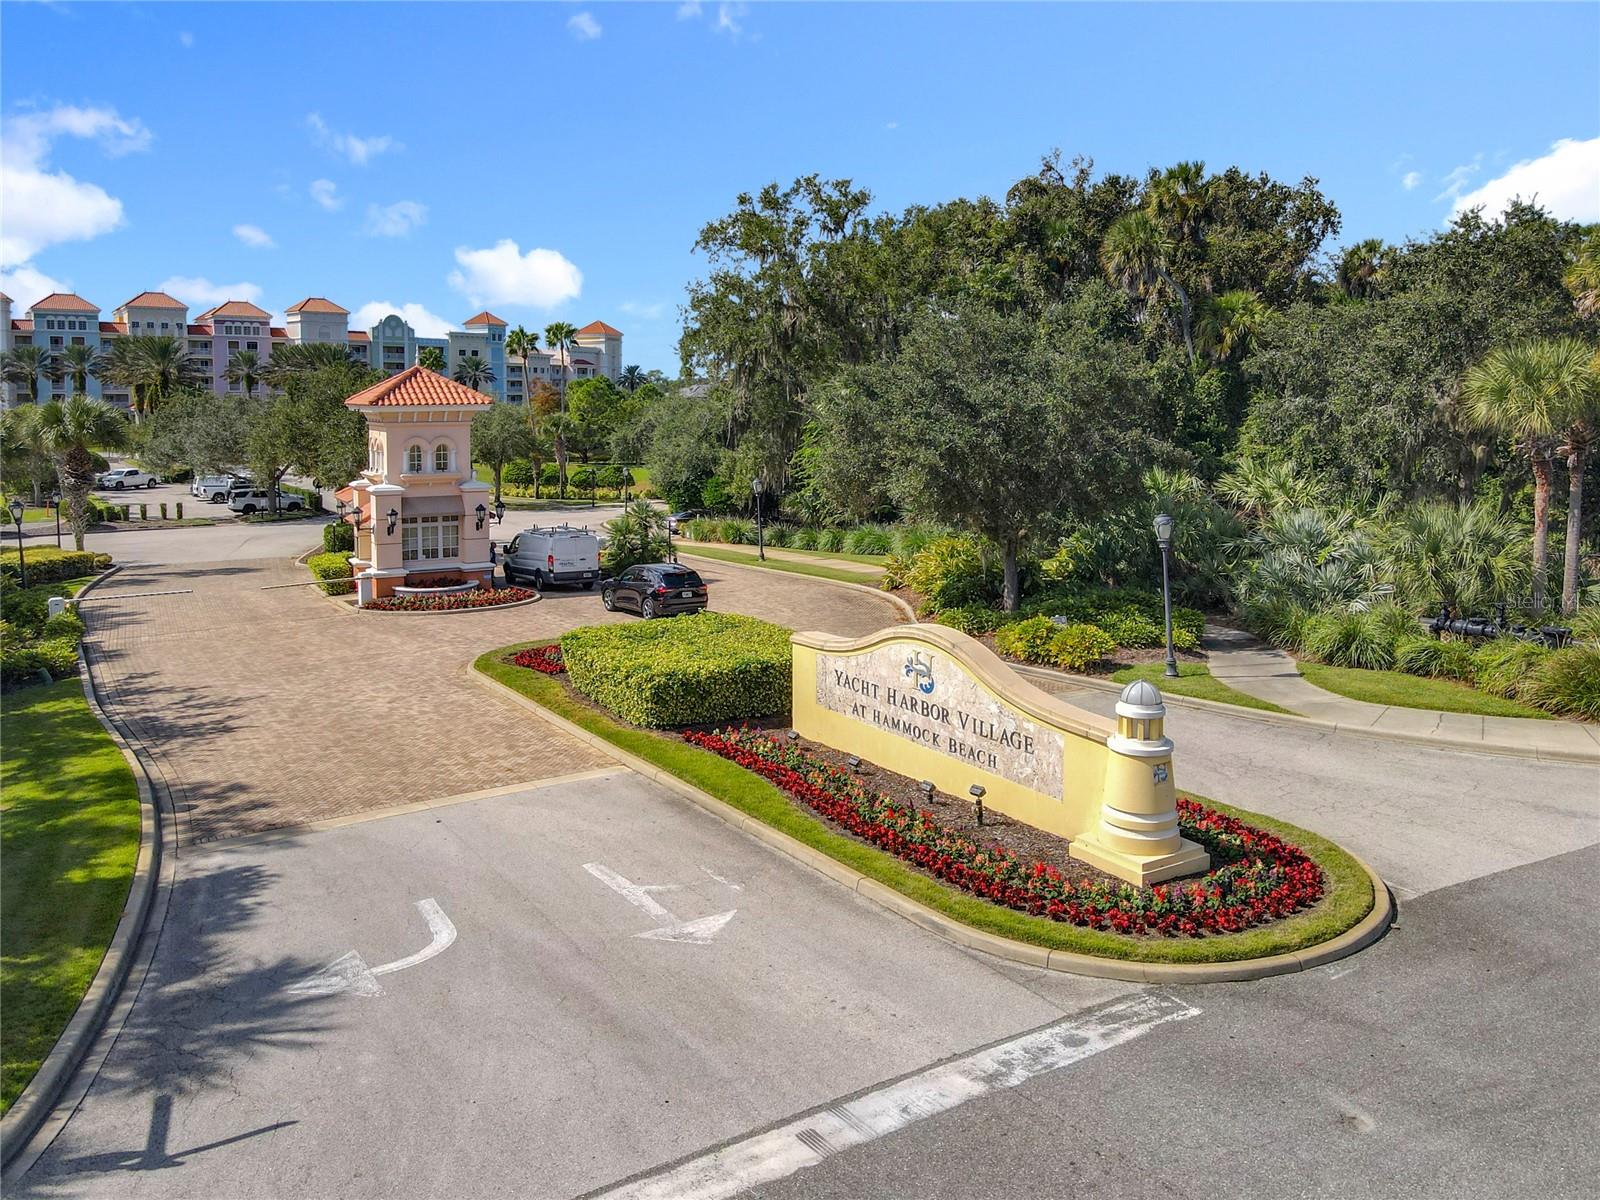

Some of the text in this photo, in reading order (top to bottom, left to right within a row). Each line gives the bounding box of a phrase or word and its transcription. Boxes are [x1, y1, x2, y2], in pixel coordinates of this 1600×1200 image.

[834, 669, 1035, 755] YACHT HARBOR VILLAGE
[852, 702, 997, 769] AT HAMMOCK BEACH
